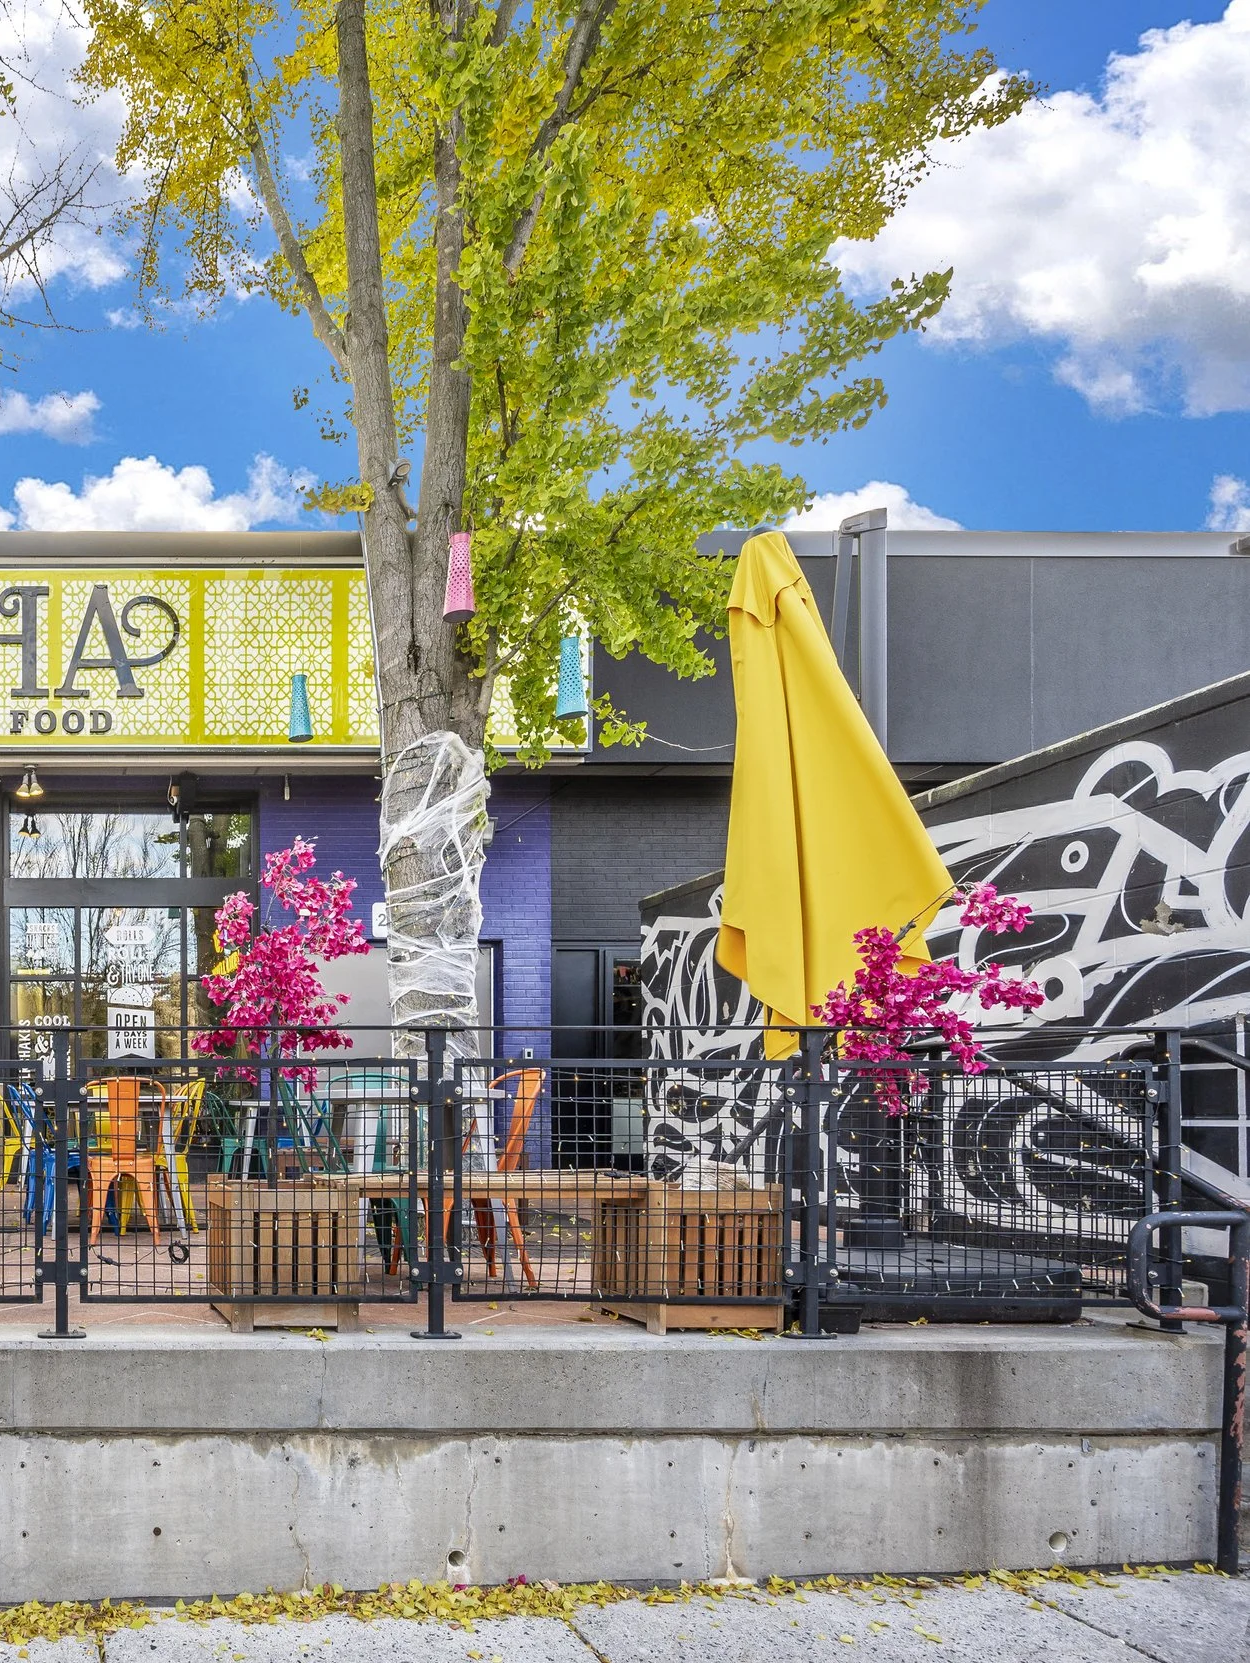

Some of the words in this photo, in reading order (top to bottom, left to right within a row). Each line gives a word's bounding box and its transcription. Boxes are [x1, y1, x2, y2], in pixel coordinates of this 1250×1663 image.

[9, 709, 114, 734] FOOD
[116, 929, 144, 941] ROLLS
[137, 963, 155, 982] ONE
[34, 1015, 71, 1027] COOL
[116, 1013, 147, 1027] OPEN
[115, 1038, 121, 1049] A
[124, 1038, 148, 1049] WEEK
